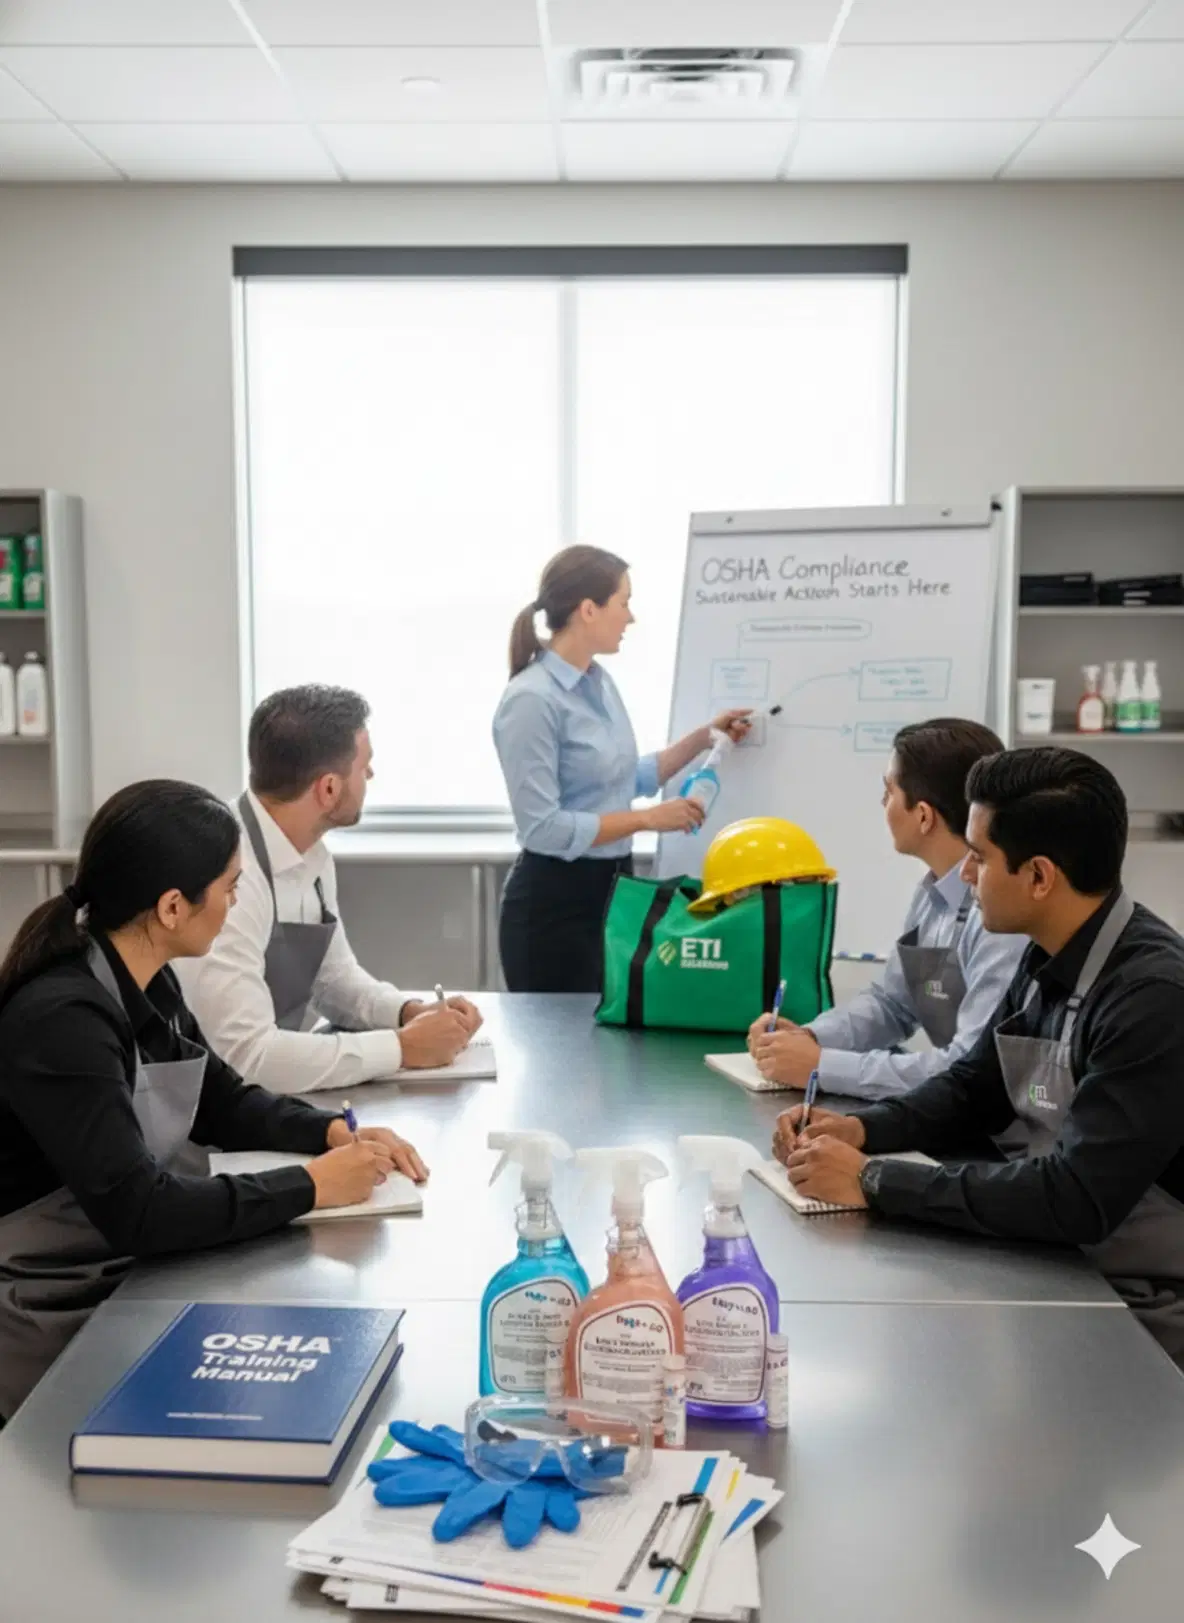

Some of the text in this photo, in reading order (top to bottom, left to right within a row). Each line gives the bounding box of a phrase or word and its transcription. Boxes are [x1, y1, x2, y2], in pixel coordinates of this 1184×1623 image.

[702, 553, 910, 585] OSHA Compliance
[848, 581, 900, 599] Starts
[907, 578, 951, 597] Here
[682, 937, 721, 959] ETI
[202, 1332, 331, 1354] OSHA
[203, 1350, 319, 1372] Training
[191, 1365, 302, 1383] Manual
